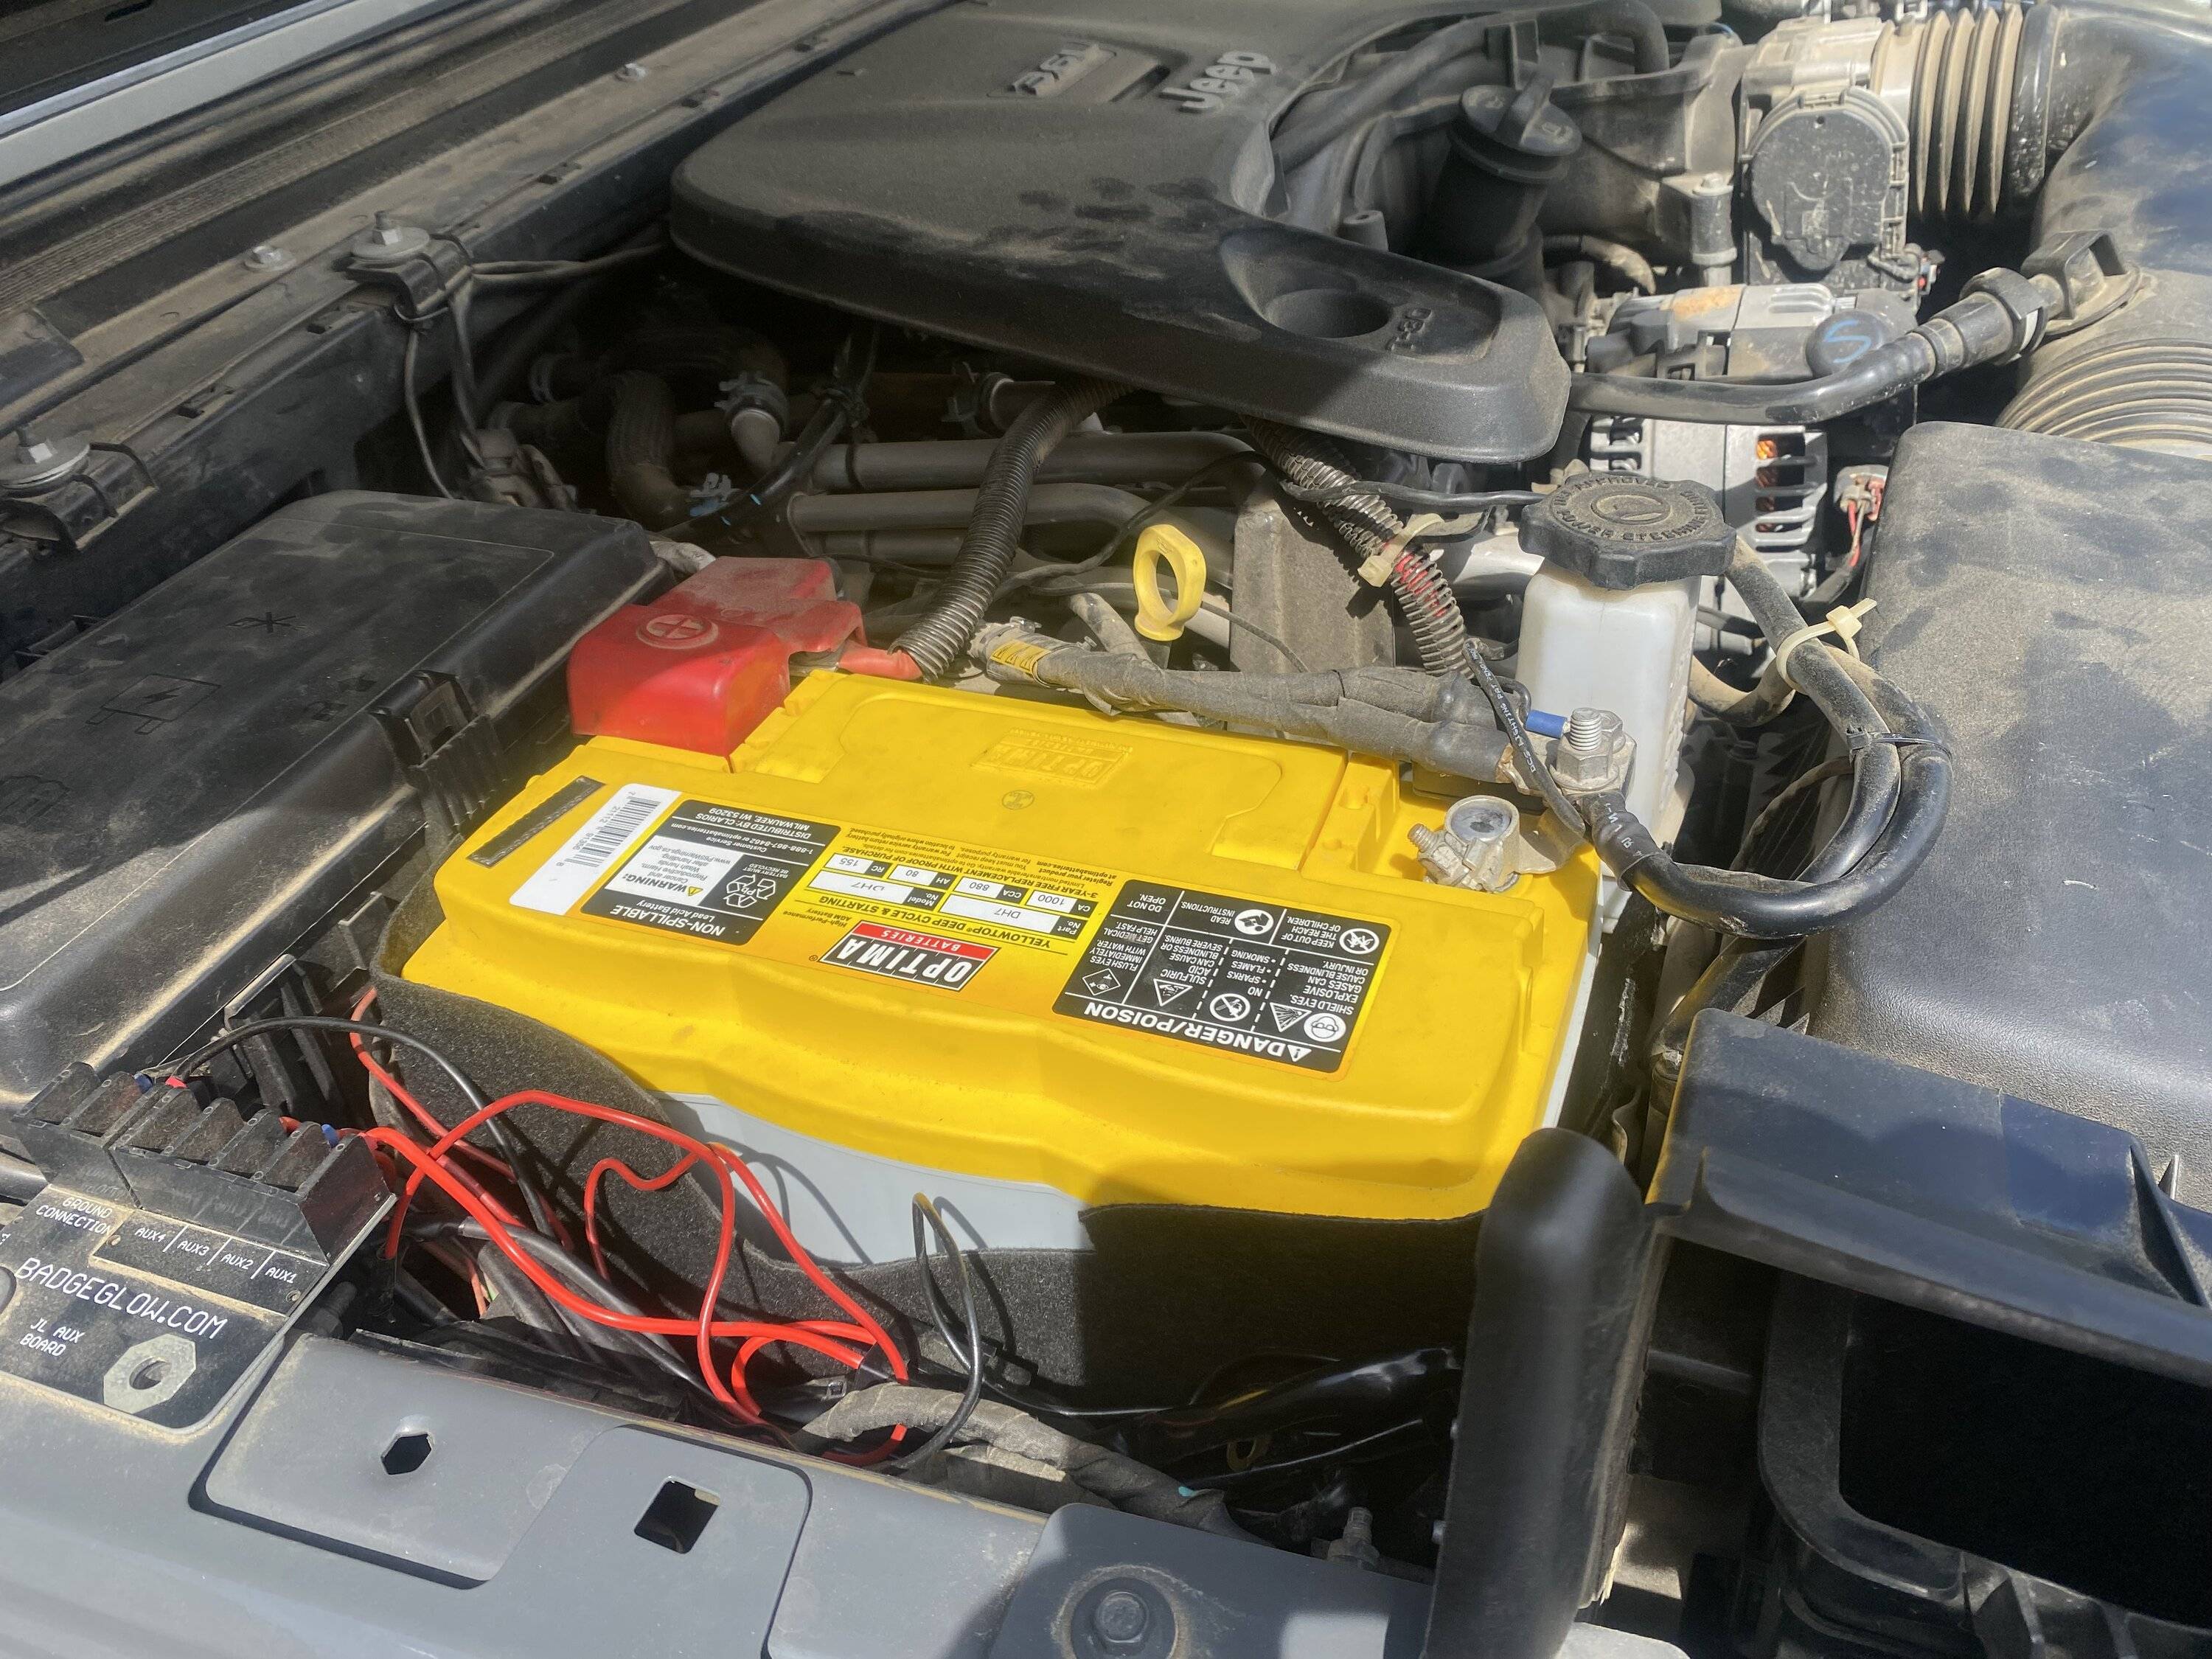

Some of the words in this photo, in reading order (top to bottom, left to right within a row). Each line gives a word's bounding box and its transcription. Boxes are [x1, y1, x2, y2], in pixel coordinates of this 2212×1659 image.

[1163, 51, 1275, 109] Jeep
[1491, 683, 1503, 700] PAT
[1500, 703, 1524, 747] LIGHTING
[709, 807, 740, 818] 53209
[695, 813, 736, 825] CLARIOS
[735, 820, 751, 829] BY:
[754, 815, 810, 831] MILWAUKEE,
[670, 823, 742, 840] optimabatteries.com
[750, 824, 812, 839] DISTRIBUTED
[706, 836, 733, 846] Service
[731, 841, 768, 853] Customer
[842, 846, 894, 860] PURCHASE.
[657, 860, 681, 869] hands
[748, 863, 781, 873] RECYCLED
[838, 858, 859, 867] 155
[905, 858, 939, 869] PROOF
[938, 863, 964, 873] WITH
[662, 867, 709, 881] Reproductive
[680, 864, 700, 873] Wash
[759, 869, 788, 879] BATTERY
[871, 865, 885, 873] RC
[905, 869, 919, 877] 80
[1038, 868, 1068, 877] product
[662, 874, 689, 884] Cancer
[935, 877, 951, 885] AH
[963, 868, 1035, 886] REPLACEMENT
[1082, 876, 1113, 887] Register
[622, 873, 688, 893] WARNING:
[969, 882, 990, 891] 880
[1034, 881, 1061, 891] FREE
[740, 886, 757, 896] Pb
[1003, 889, 1022, 899] CCA
[1060, 886, 1099, 899] 3-YEAR
[907, 896, 935, 907] Model
[925, 893, 939, 901] No.
[1037, 894, 1065, 905] 1000
[1139, 894, 1166, 905] OPEN.
[636, 900, 672, 914] Battery
[818, 896, 880, 914] STARTING
[1077, 904, 1091, 912] CA
[1126, 900, 1148, 910] NOT
[1147, 904, 1163, 913] DO
[1180, 901, 1236, 917] INSTRUCTIONS.
[669, 908, 693, 917] Acid
[689, 912, 715, 922] Lead
[806, 908, 834, 919] Battery
[881, 907, 891, 916] &
[890, 909, 932, 924] CYCLE
[993, 908, 1021, 919] DH7
[609, 905, 726, 936] NON-SPILLABLE
[782, 911, 848, 928] High-Performance
[832, 914, 852, 922] AGM
[1210, 915, 1232, 925] READ
[1287, 916, 1329, 931] CHILDREN.
[931, 918, 967, 931] DEEP
[1057, 925, 1078, 935] Part
[1067, 920, 1082, 929] No.
[1115, 921, 1137, 932] FAST.
[1328, 924, 1341, 933] OF
[1103, 927, 1138, 941] MEDICAL
[1135, 926, 1158, 936] HELP
[1291, 925, 1321, 937] REACH
[1319, 931, 1337, 941] THE
[880, 930, 961, 952] BATTERIES
[1135, 934, 1154, 944] GET
[1164, 934, 1193, 946] BURNS.
[1281, 933, 1294, 941] OF
[1293, 935, 1312, 945] OUT
[1096, 939, 1125, 952] WATER.
[1160, 942, 1173, 951] OR
[1191, 939, 1223, 952] SEVERE
[1311, 938, 1335, 949] KEEP
[1089, 947, 1143, 964] IMMEDIATELY
[1124, 945, 1147, 956] WITH
[1172, 945, 1220, 960] BLINDNESS
[836, 938, 973, 983] OPTIMA
[1090, 956, 1113, 967] EYES
[1169, 953, 1197, 964] CAUSE
[1231, 950, 1270, 964] SMOKING
[1110, 959, 1138, 972] FLUSH
[1196, 958, 1215, 968] CAN
[1231, 960, 1266, 974] FLAMES
[1322, 961, 1356, 974] INJURY.
[1188, 965, 1212, 976] ACID
[1287, 963, 1336, 979] BLINDNESS
[1354, 967, 1368, 976] OR
[1160, 969, 1207, 985] SULFURIC
[1226, 970, 1262, 984] SPARKS
[1307, 975, 1327, 986] CAN
[1335, 972, 1366, 984] CAUSE
[1247, 987, 1263, 997] NO
[1327, 980, 1363, 994] GASES
[1302, 984, 1359, 1004] EXPLOSIVE
[1290, 994, 1318, 1008] EYES.
[1317, 1001, 1354, 1015] SHIELD
[1083, 1001, 1286, 1057] DANGER/POISON
[62, 1197, 113, 1219] GROUND
[134, 1227, 167, 1243] AUX4
[177, 1240, 210, 1256] AUX3
[220, 1253, 254, 1270] AUX2
[265, 1267, 298, 1284] AUX1
[14, 1257, 229, 1340] BADGEGLOW.COM
[30, 1318, 46, 1333] JL
[53, 1326, 86, 1344] AUX
[19, 1332, 67, 1357] BOARD
